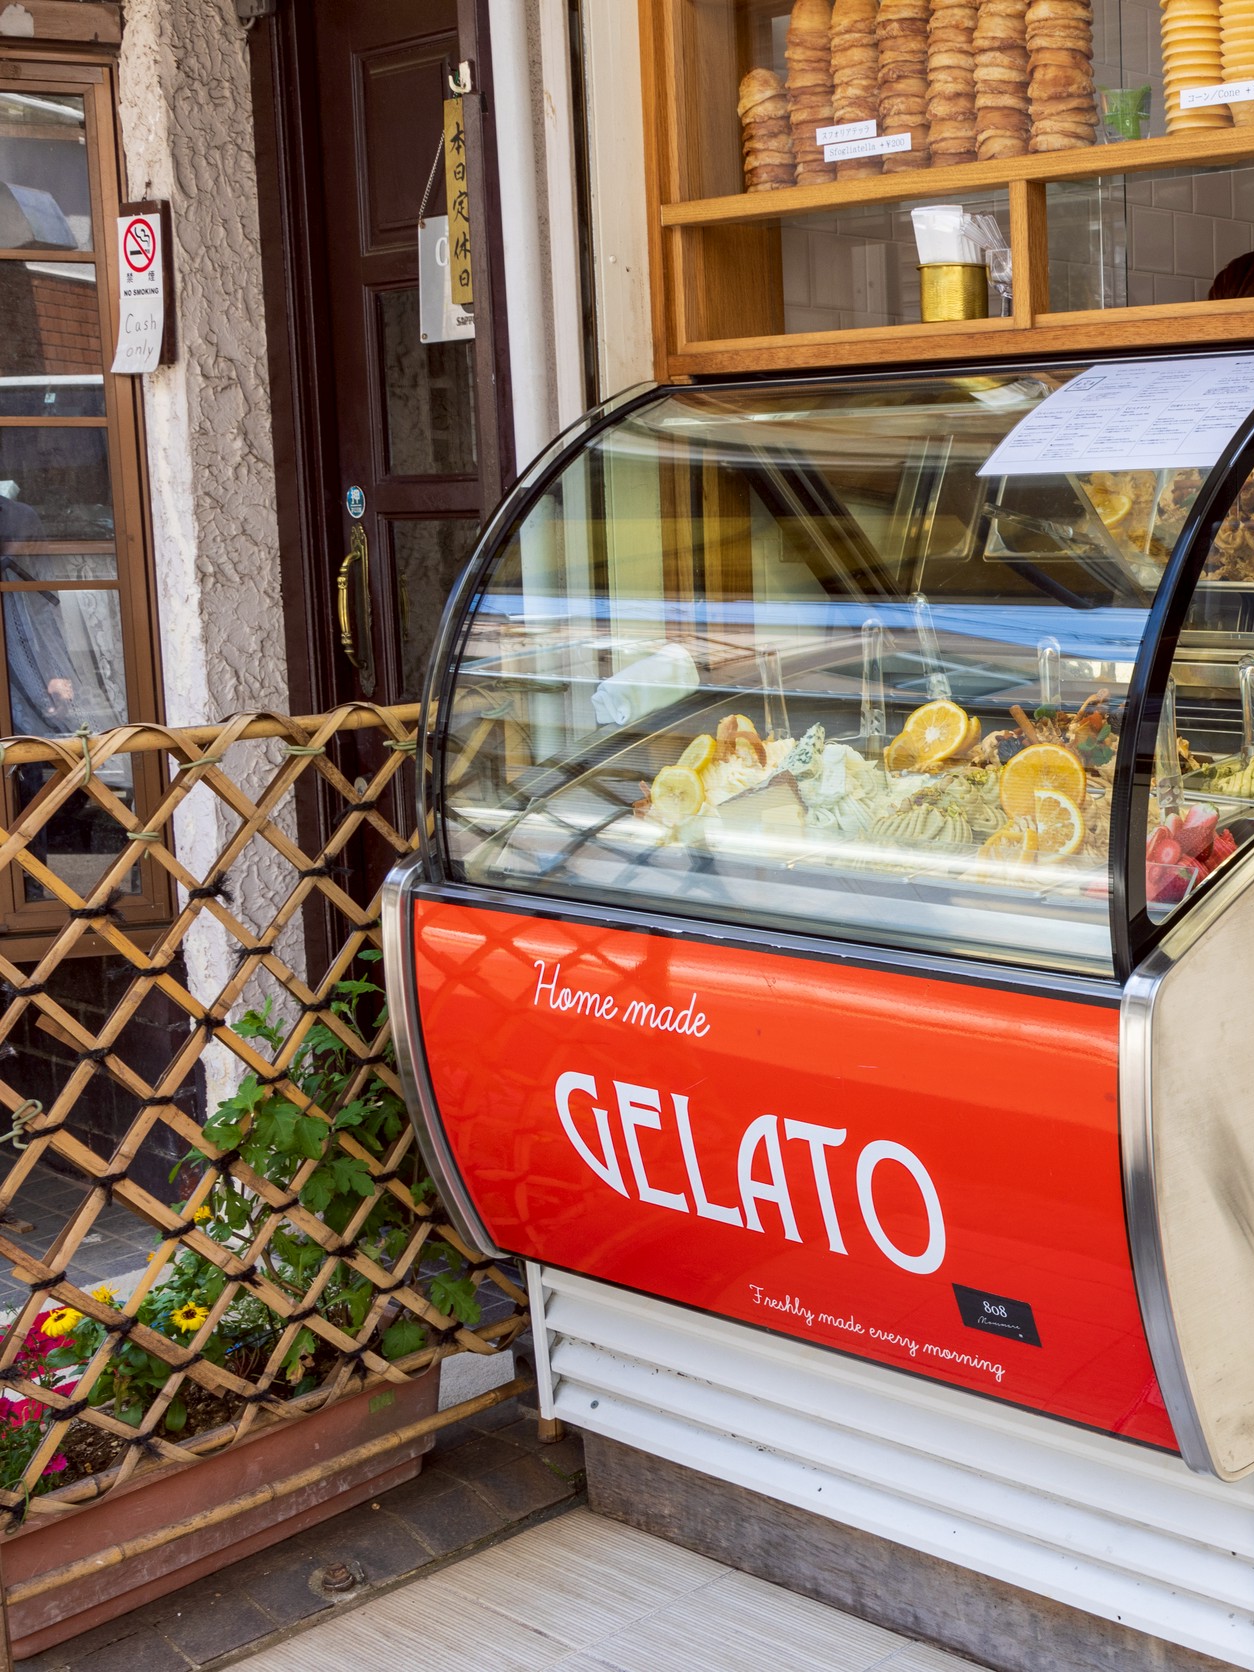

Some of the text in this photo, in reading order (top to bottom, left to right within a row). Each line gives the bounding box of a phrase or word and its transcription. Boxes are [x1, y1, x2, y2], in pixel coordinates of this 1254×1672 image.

[829, 142, 876, 157] Sfogliatella
[450, 121, 472, 288] 本日定休日
[133, 287, 160, 296] SMOKING
[125, 313, 157, 334] Cash
[126, 339, 154, 364] only
[533, 959, 711, 1038] Home made
[554, 1071, 946, 1275] GELATO
[983, 1300, 1008, 1318] 808
[749, 1284, 1006, 1382] Freshly made every morning
